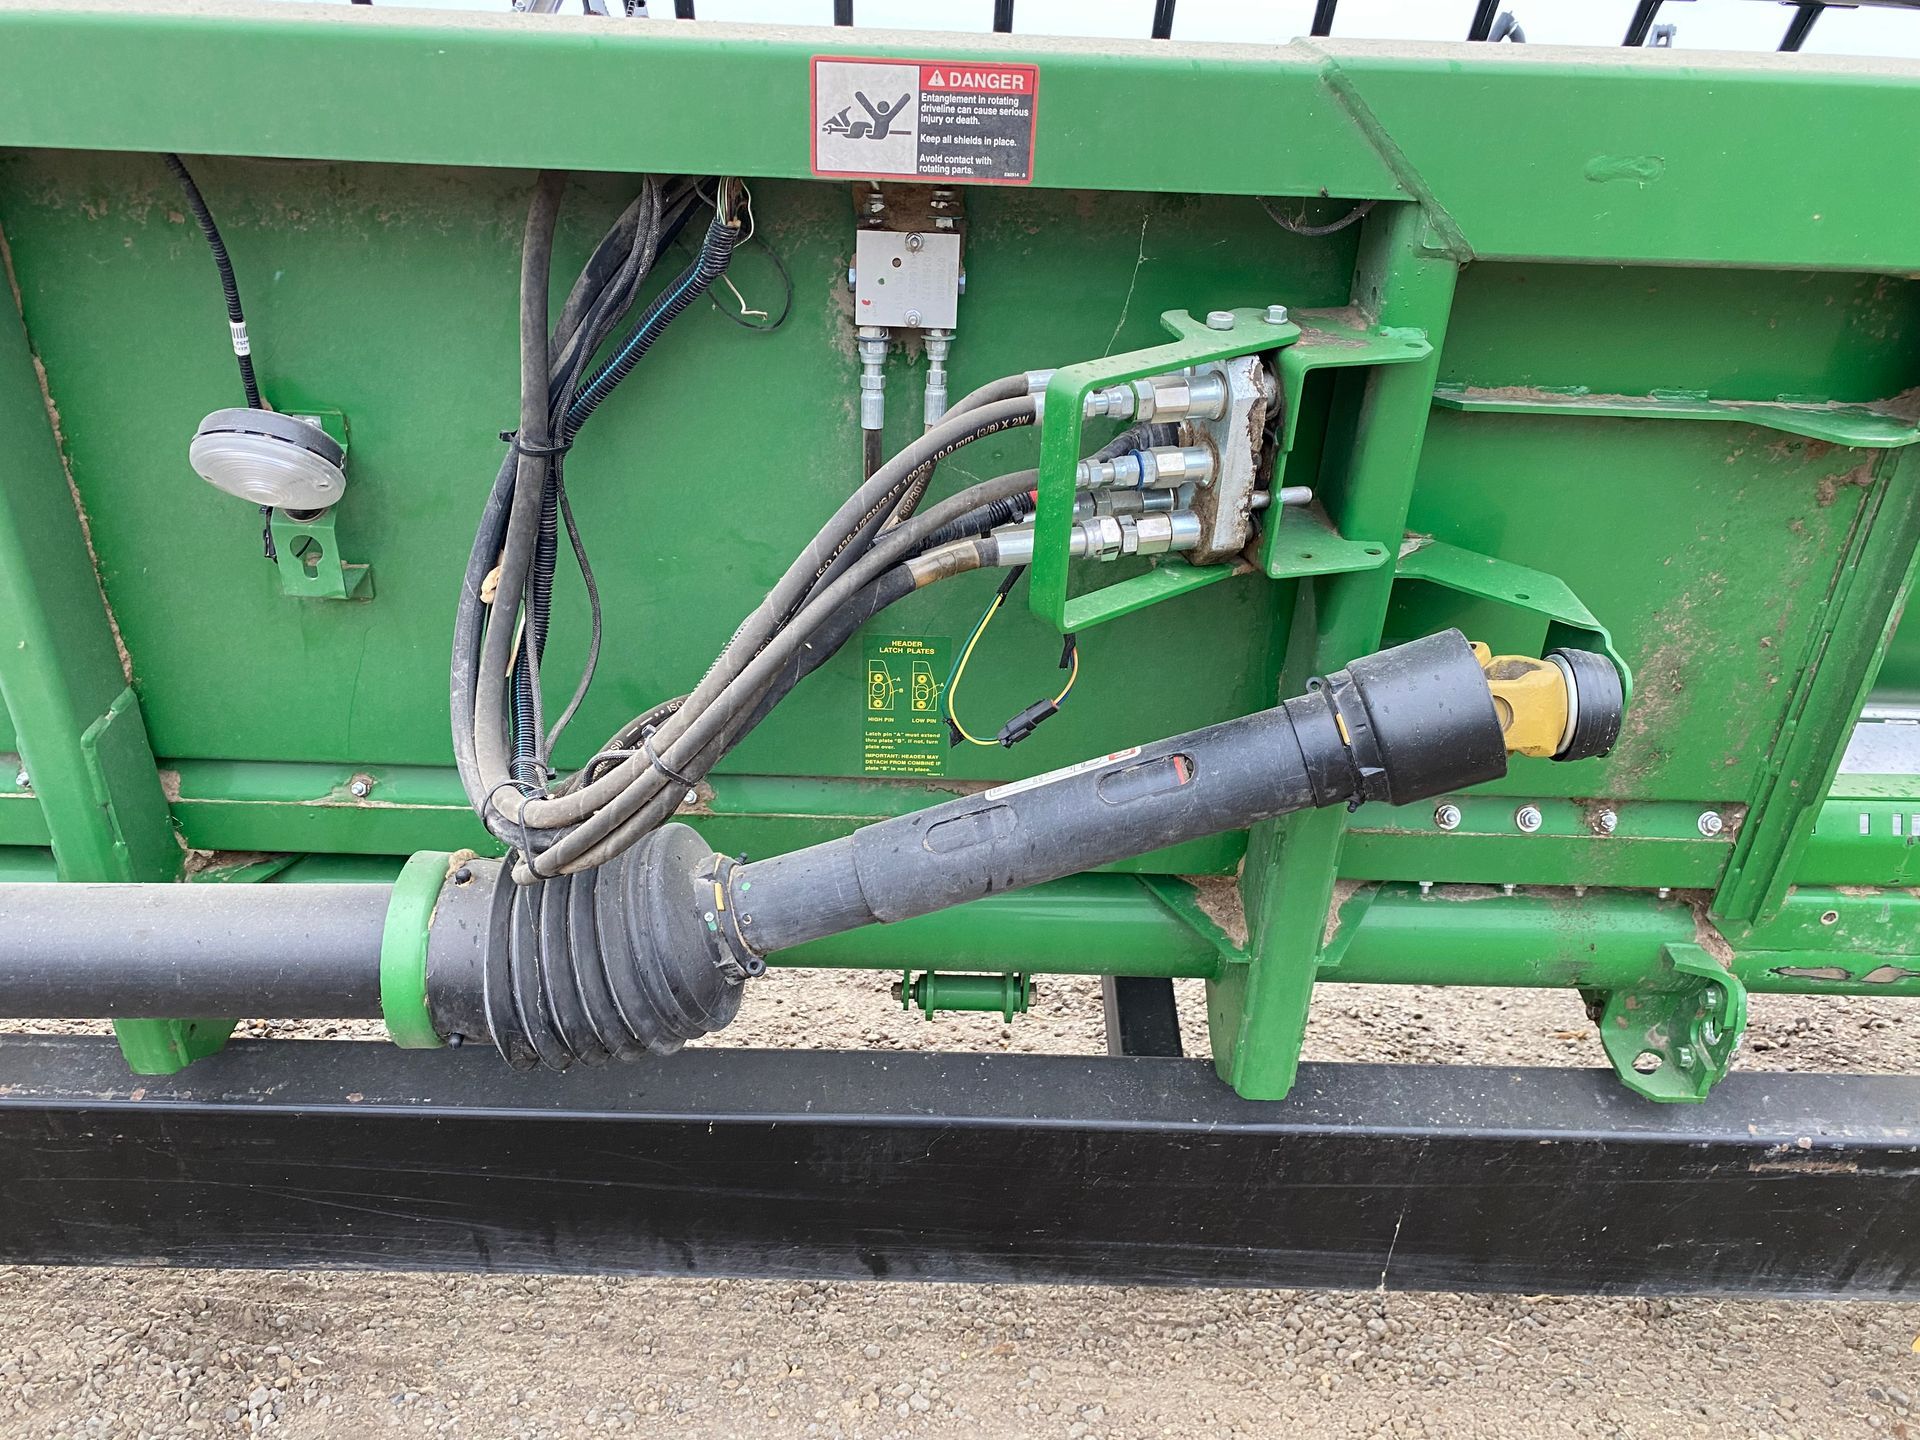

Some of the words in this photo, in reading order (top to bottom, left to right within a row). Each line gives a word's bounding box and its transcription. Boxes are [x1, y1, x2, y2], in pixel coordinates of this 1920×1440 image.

[949, 72, 1024, 90] DANGER
[921, 93, 977, 105] Entanglement
[978, 96, 986, 104] in
[988, 96, 1019, 107] rotating
[921, 103, 956, 114] driveline
[973, 107, 997, 115] cause
[999, 106, 1029, 116] serious
[921, 114, 943, 125] injury
[955, 115, 980, 125] death.
[920, 134, 941, 145] Keep
[942, 135, 952, 144] all
[954, 135, 982, 145] shields
[984, 136, 992, 145] in
[993, 137, 1017, 147] place.
[920, 154, 943, 163] Avoid
[944, 156, 973, 165] contact
[975, 155, 992, 165] with
[919, 164, 949, 174] rotating
[951, 166, 973, 175] parts.
[933, 445, 953, 463] 10.0
[955, 435, 975, 450] mm
[976, 422, 999, 439] (3/8)
[1002, 419, 1009, 428] X
[1012, 415, 1030, 427] 2W
